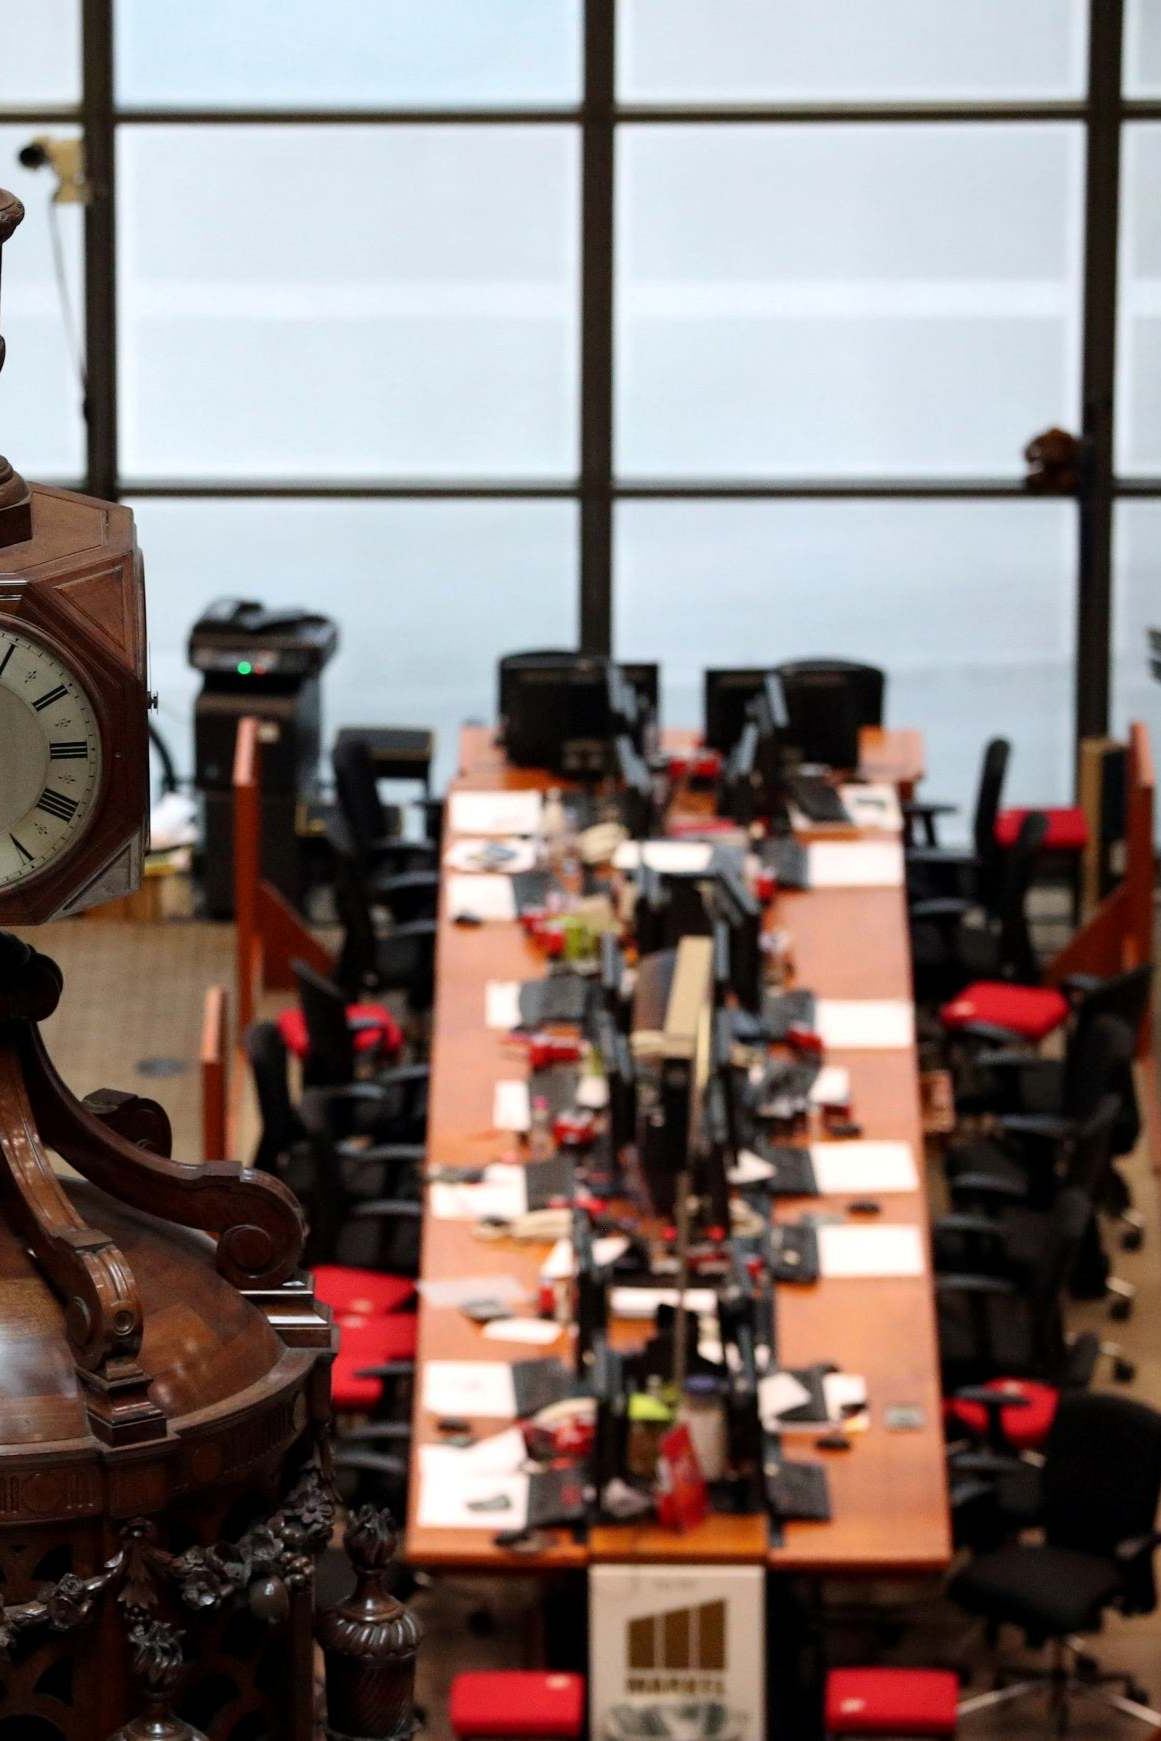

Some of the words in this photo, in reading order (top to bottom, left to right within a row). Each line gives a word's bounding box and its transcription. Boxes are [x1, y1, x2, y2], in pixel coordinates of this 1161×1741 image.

[32, 684, 70, 713] II
[49, 741, 88, 761] III
[35, 787, 80, 823] IIII
[9, 832, 35, 866] V
